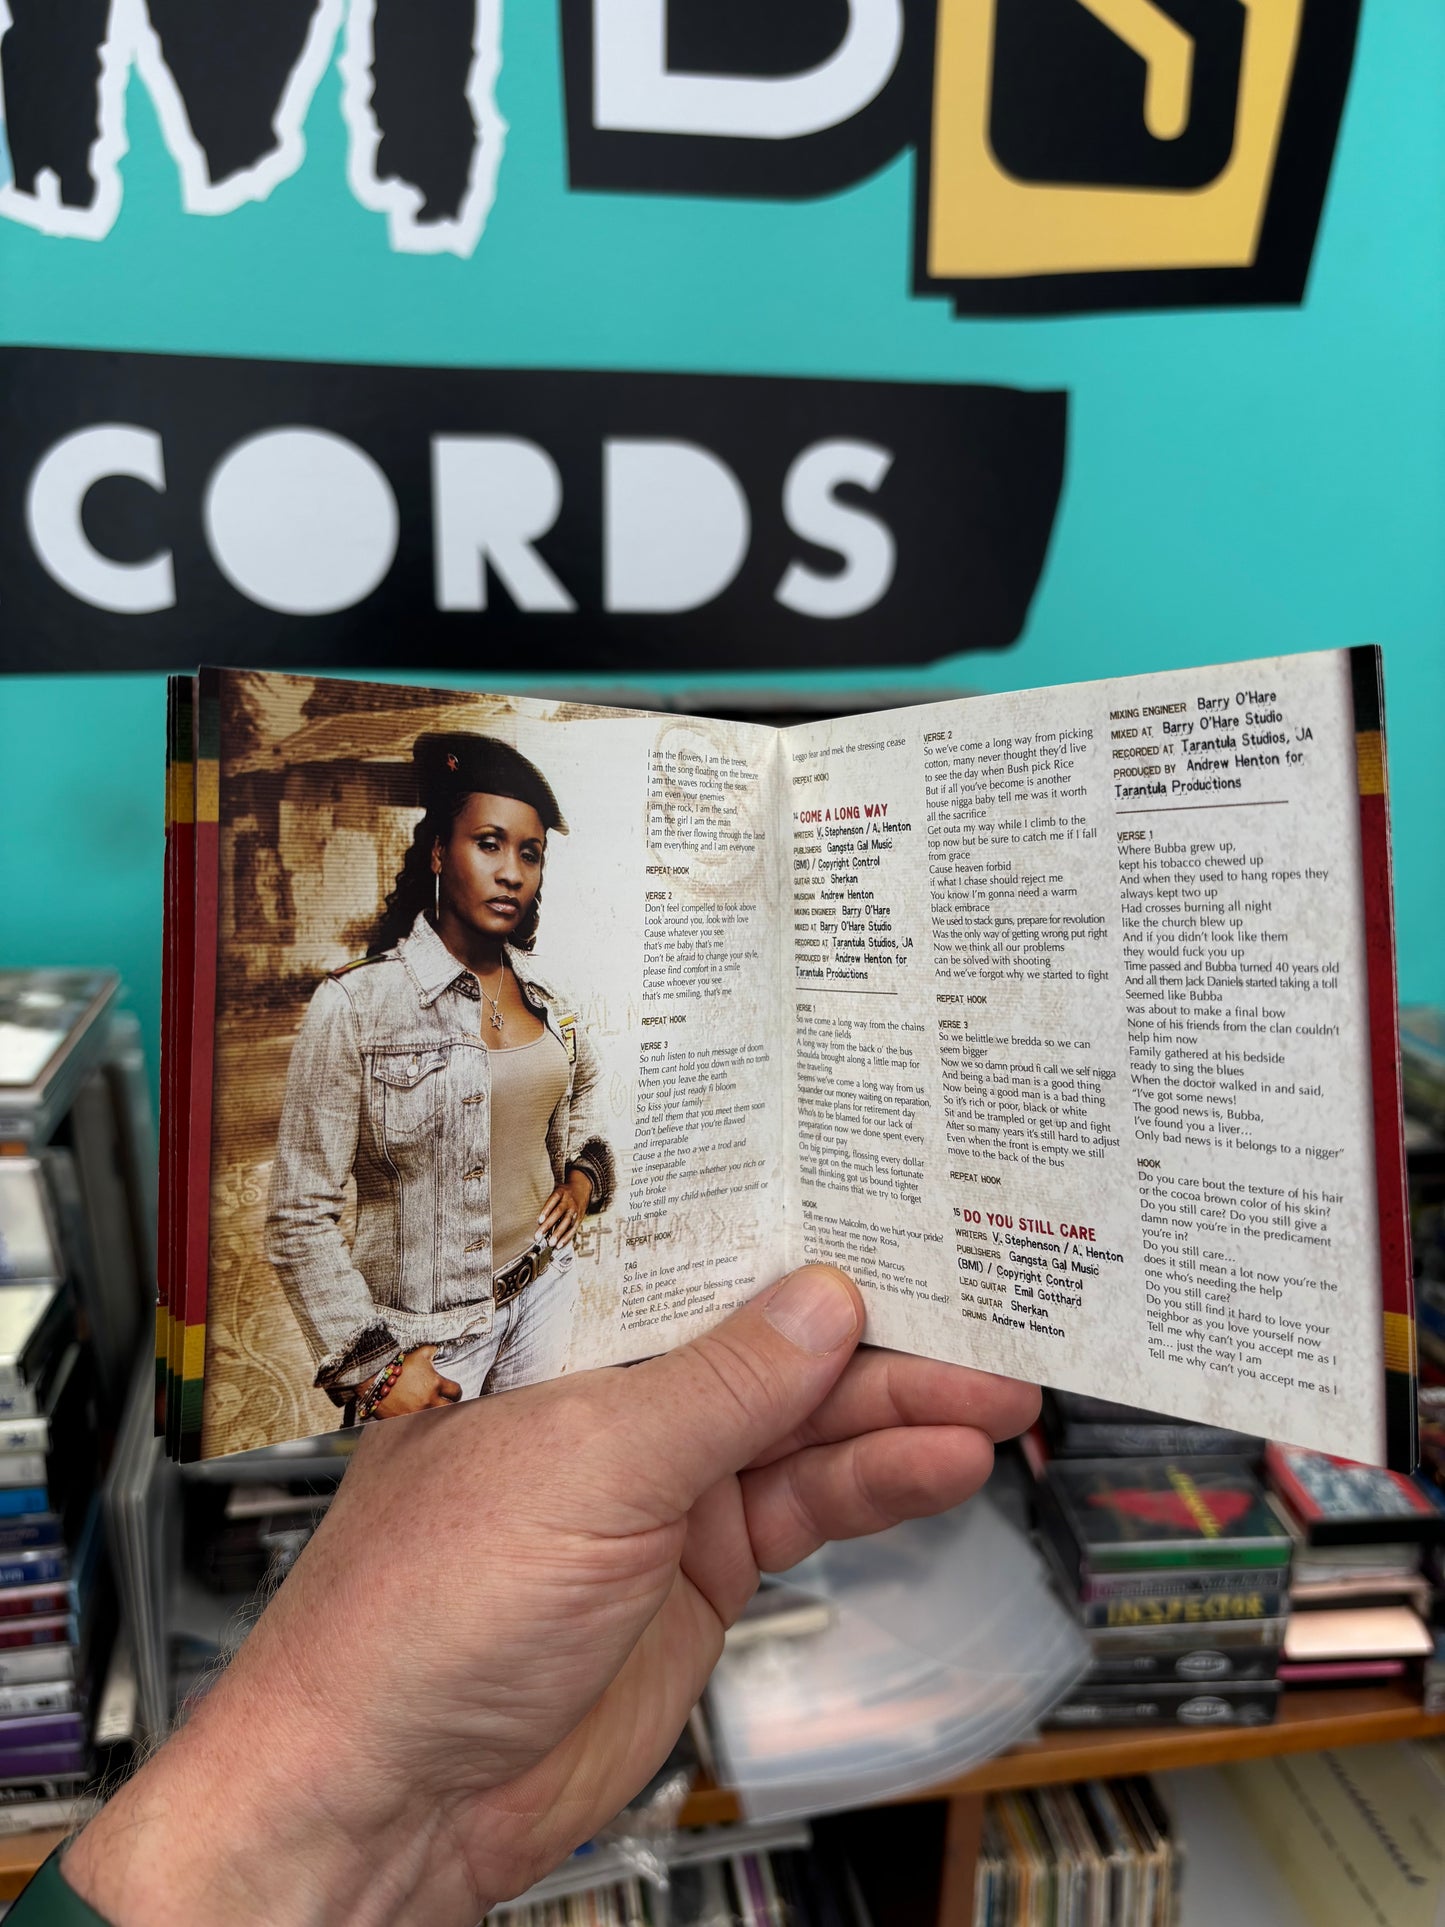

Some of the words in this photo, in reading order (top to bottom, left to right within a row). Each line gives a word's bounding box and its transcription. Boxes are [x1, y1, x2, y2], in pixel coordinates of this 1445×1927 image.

[1110, 708, 1139, 720] MIXING
[1142, 702, 1186, 716] ENGINEER
[1197, 697, 1229, 711] Barry
[1235, 691, 1276, 705] O'Hare
[1111, 728, 1138, 739] MIXED
[1141, 726, 1152, 736] AT
[1162, 721, 1193, 734] Barry
[1200, 715, 1239, 729] O'Hare
[1245, 710, 1282, 725] Studio
[923, 731, 945, 742] VERSE
[948, 730, 952, 739] 2
[923, 746, 933, 755] So
[935, 744, 957, 753] we've
[960, 742, 982, 751] come
[993, 738, 1012, 749] long
[1014, 736, 1032, 746] way
[1035, 732, 1056, 742] from
[1059, 728, 1093, 742] picking
[1112, 745, 1159, 759] RECORDED
[1163, 744, 1173, 753] AT
[1181, 735, 1236, 752] Tarantula
[1242, 731, 1289, 746] Studios,
[1295, 727, 1312, 741] JA
[924, 760, 950, 769] cotton,
[953, 757, 975, 766] many
[977, 754, 1000, 762] never
[1003, 747, 1036, 761] thought
[1039, 743, 1066, 757] they'd
[1070, 742, 1086, 752] live
[1113, 765, 1161, 778] PRODUCED
[1164, 764, 1175, 773] BY
[1186, 758, 1228, 771] Andrew
[1234, 754, 1279, 767] Henton
[1285, 751, 1303, 762] for
[1114, 781, 1166, 797] Tarantula
[1172, 777, 1241, 792] Productions
[800, 810, 822, 823] COME
[825, 809, 830, 821] A
[834, 806, 860, 820] LONG
[864, 803, 887, 817] WAY
[794, 830, 813, 838] WRITERS
[816, 827, 823, 837] V.
[825, 825, 863, 837] Stephenson
[872, 823, 880, 833] A.
[882, 822, 911, 832] Henton
[1117, 830, 1146, 841] VERSE
[793, 845, 821, 854] PUBLISHERS
[827, 842, 854, 854] Gangsta
[857, 839, 868, 853] Gal
[871, 839, 892, 849] Music
[1117, 844, 1150, 855] Where
[1154, 842, 1186, 853] Bubba
[1190, 844, 1215, 855] grew
[1219, 842, 1235, 853] up,
[793, 858, 809, 870] (BMI)
[818, 857, 849, 871] Copyright
[852, 855, 879, 869] Control
[928, 851, 946, 860] from
[948, 852, 970, 862] grace
[646, 865, 672, 874] REPEAT
[673, 866, 689, 874] HOOK
[929, 864, 952, 874] Cause
[954, 863, 983, 872] heaven
[986, 860, 1011, 871] forbid
[794, 877, 810, 885] GUITAR
[812, 876, 825, 884] SOLO
[830, 873, 858, 883] Sherkan
[645, 891, 666, 899] VERSE
[668, 891, 672, 899] 2
[842, 905, 861, 918] Barry
[864, 904, 890, 917] O'Hare
[930, 903, 952, 912] black
[954, 902, 990, 912] embrace
[820, 921, 838, 933] Barry
[841, 920, 864, 931] O'Hare
[868, 920, 891, 931] Studio
[1122, 917, 1140, 927] like
[1142, 916, 1158, 927] the
[1161, 916, 1196, 927] church
[1200, 916, 1225, 926] blew
[1229, 919, 1243, 929] up
[795, 938, 820, 946] RECORDED
[832, 936, 865, 949] Tarantula
[868, 937, 898, 949] Studios,
[902, 937, 913, 947] JA
[795, 954, 820, 962] PRODUCED
[835, 952, 860, 962] Andrew
[864, 953, 892, 964] Henton
[895, 954, 907, 964] for
[795, 966, 823, 979] Tarantula
[826, 967, 868, 979] Productions
[936, 994, 963, 1003] REPEAT
[966, 995, 987, 1003] HOOK
[938, 1020, 961, 1029] VERSE
[640, 1041, 661, 1050] VERSE
[638, 1078, 660, 1087] When
[662, 1078, 676, 1088] you
[678, 1075, 696, 1083] leave
[697, 1072, 709, 1081] the
[710, 1070, 727, 1080] earth
[636, 1103, 646, 1113] So
[648, 1102, 661, 1111] kiss
[663, 1100, 680, 1112] your
[682, 1096, 705, 1107] family
[1137, 1158, 1160, 1168] HOOK
[953, 1207, 960, 1216] 15
[963, 1209, 980, 1223] DO
[986, 1212, 1012, 1228] YOU
[1019, 1217, 1054, 1235] STILL
[1060, 1223, 1096, 1241] CARE
[955, 1228, 987, 1240] WRITERS
[992, 1231, 1003, 1245] V.
[1004, 1233, 1060, 1252] Stephenson
[1072, 1244, 1082, 1256] A.
[1085, 1246, 1123, 1262] Henton
[624, 1261, 637, 1270] TAG
[956, 1244, 1000, 1259] PUBLISHERS
[1009, 1250, 1048, 1270] Gangsta
[1051, 1257, 1067, 1272] Gal
[1071, 1261, 1099, 1275] Music
[957, 1258, 983, 1273] (BMI)
[996, 1265, 1041, 1283] Copyright
[1045, 1273, 1082, 1290] Control
[959, 1276, 978, 1287] LEAD
[980, 1280, 1006, 1292] GUITAR
[1014, 1284, 1033, 1297] Emil
[1037, 1288, 1081, 1306] Gotthard
[961, 1292, 974, 1302] SKA
[977, 1296, 1002, 1308] GUITAR
[1011, 1300, 1048, 1317] Sherkan
[962, 1308, 986, 1320] DRUMS
[992, 1312, 1025, 1328] Andrew
[1029, 1320, 1064, 1337] Henton
